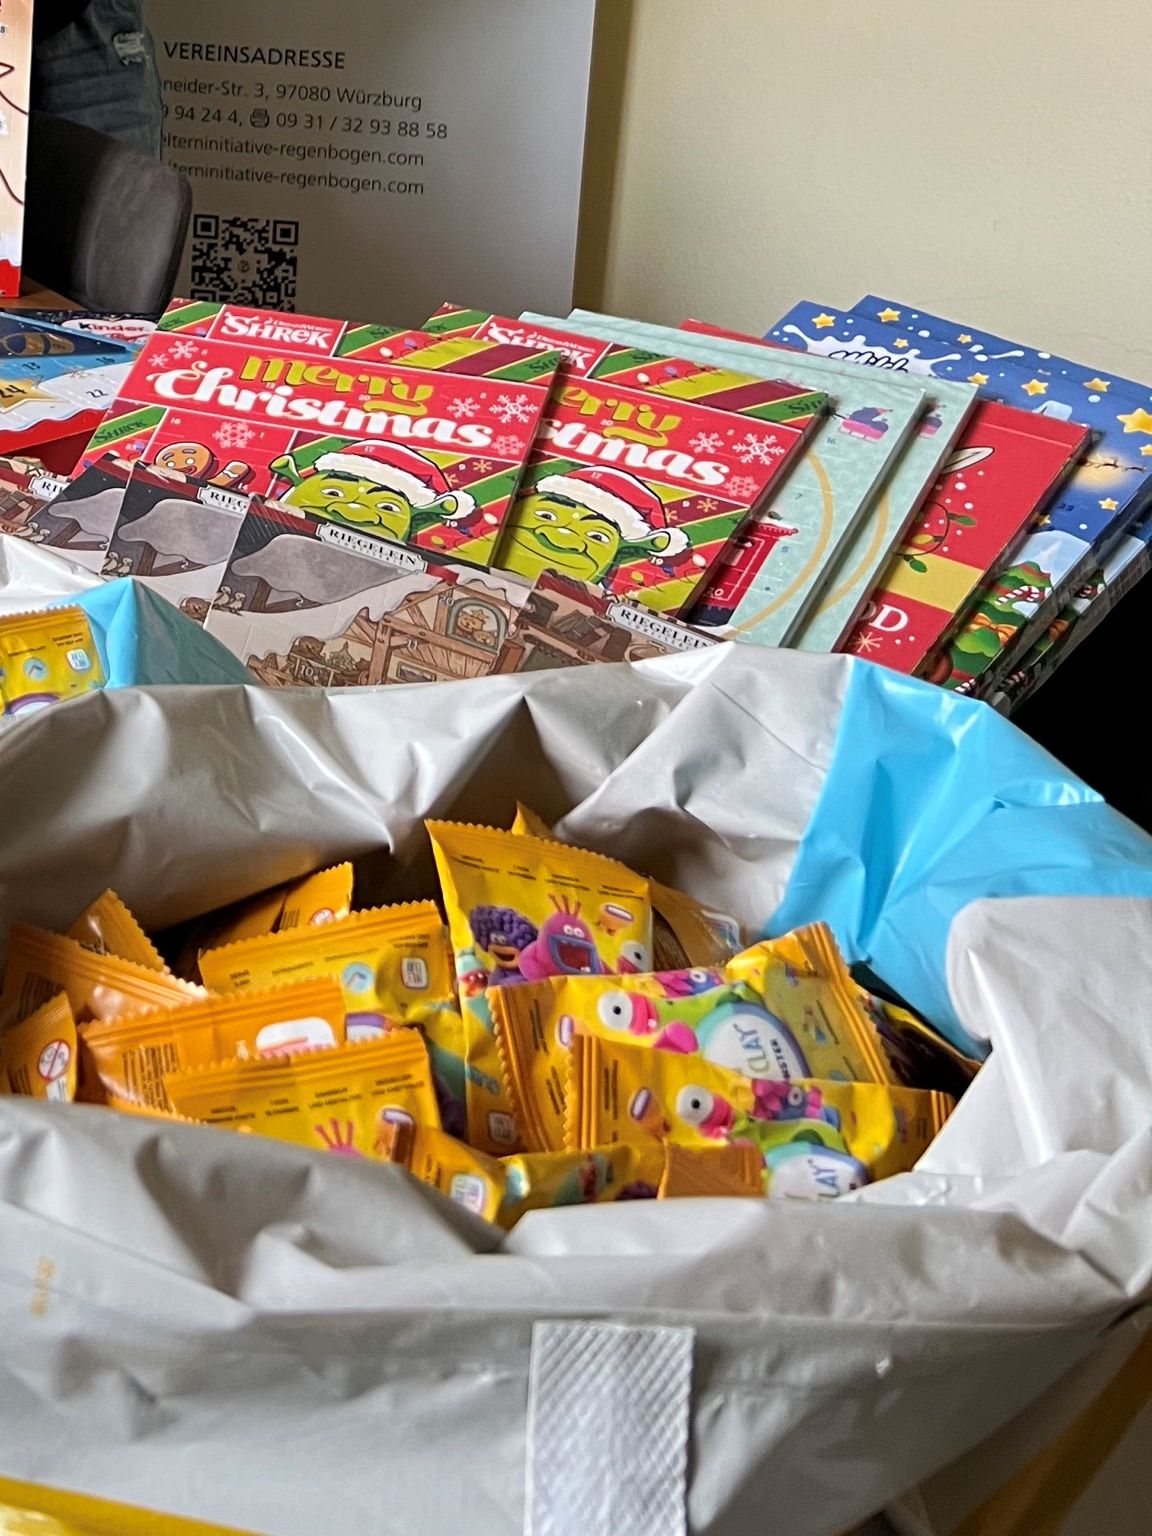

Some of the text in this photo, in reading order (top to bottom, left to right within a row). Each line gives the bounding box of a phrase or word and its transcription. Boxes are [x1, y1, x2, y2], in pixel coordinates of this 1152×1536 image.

[164, 40, 346, 69] VEREINSADRESSE
[254, 82, 270, 100] 3,
[276, 83, 330, 102] 97080
[337, 87, 422, 113] Würzburg
[174, 105, 195, 122] 94
[201, 106, 221, 123] 24
[227, 109, 243, 127] 4,
[276, 112, 298, 128] 09
[303, 114, 323, 131] 31
[342, 116, 363, 133] 32
[370, 118, 391, 135] 93
[398, 121, 419, 137] 88
[426, 123, 448, 140] 58
[162, 131, 424, 166] lterninitiative-regenbogen.com
[146, 360, 493, 449] Christmas
[556, 386, 682, 447] erry
[329, 527, 417, 566] RIEGELEIN
[732, 1022, 770, 1072] CLAY
[807, 1157, 841, 1198] LAY
